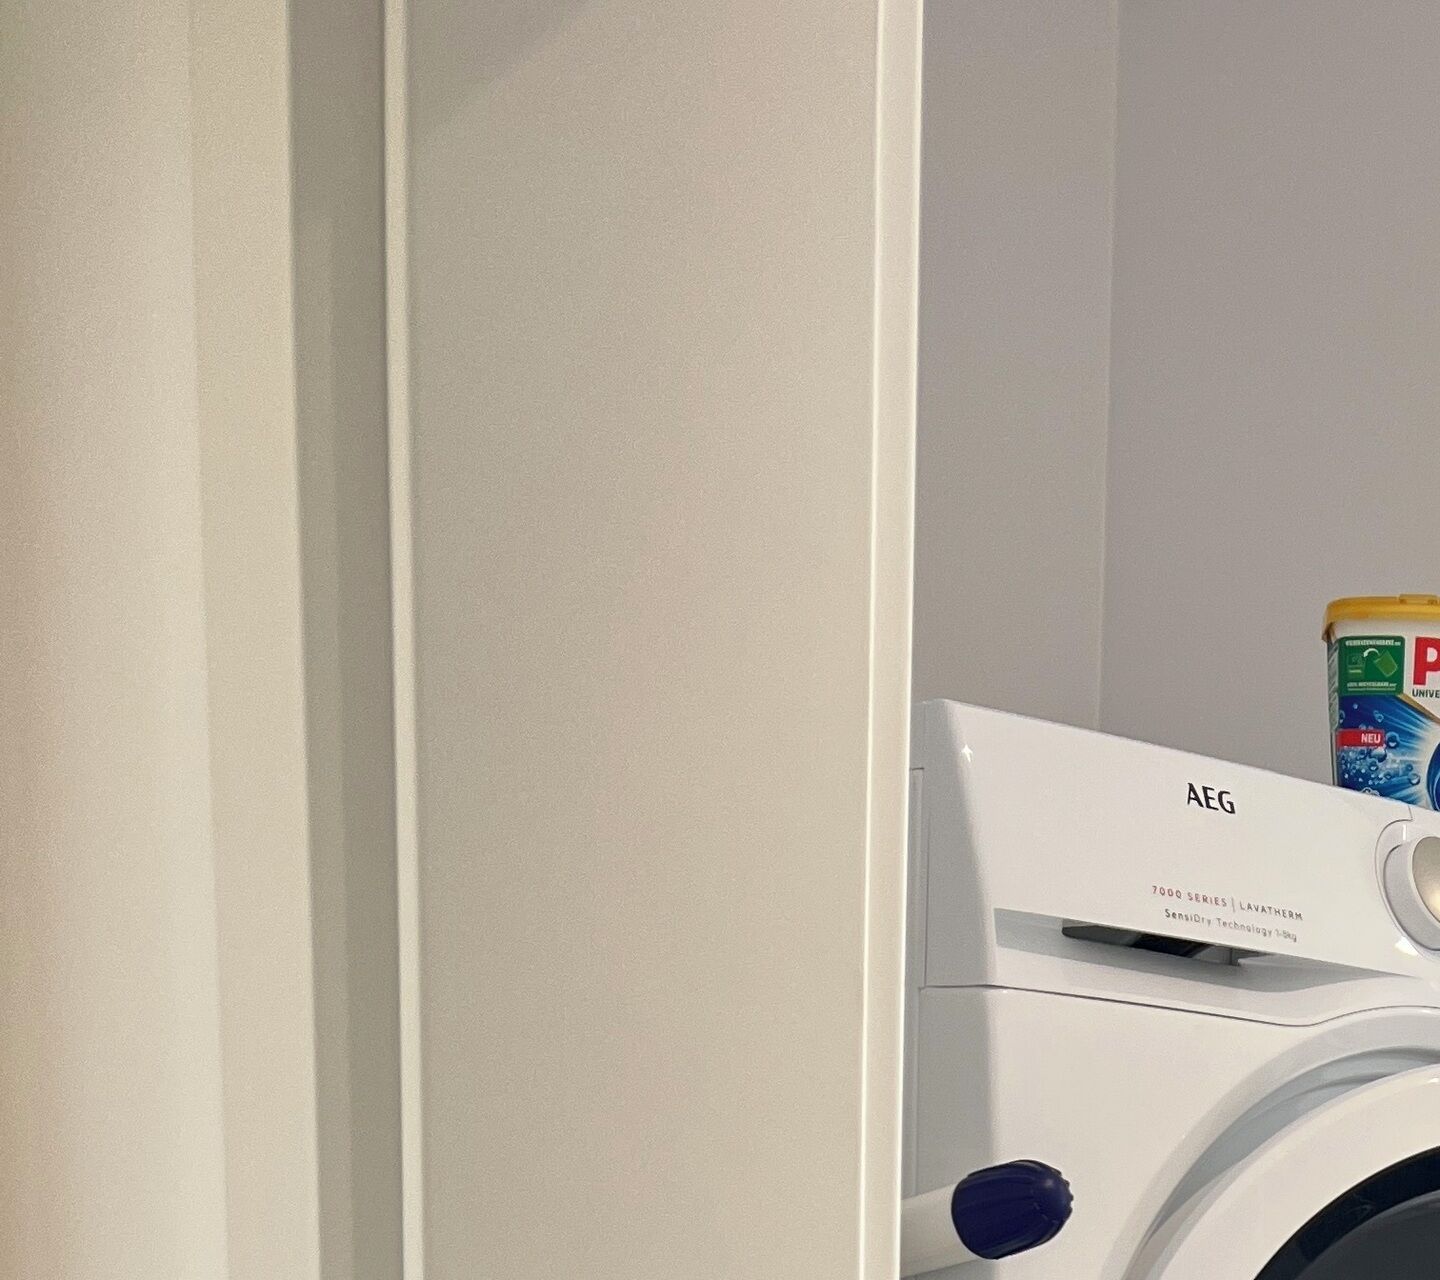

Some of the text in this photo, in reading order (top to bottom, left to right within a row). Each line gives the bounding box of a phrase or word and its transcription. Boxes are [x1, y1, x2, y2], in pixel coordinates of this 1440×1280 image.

[1361, 732, 1381, 745] NEU
[1187, 782, 1236, 814] AEG
[1152, 885, 1304, 921] 7000 SERIES LAVATHERM
[1165, 908, 1212, 927] SensiDry
[1216, 917, 1273, 937] Technology
